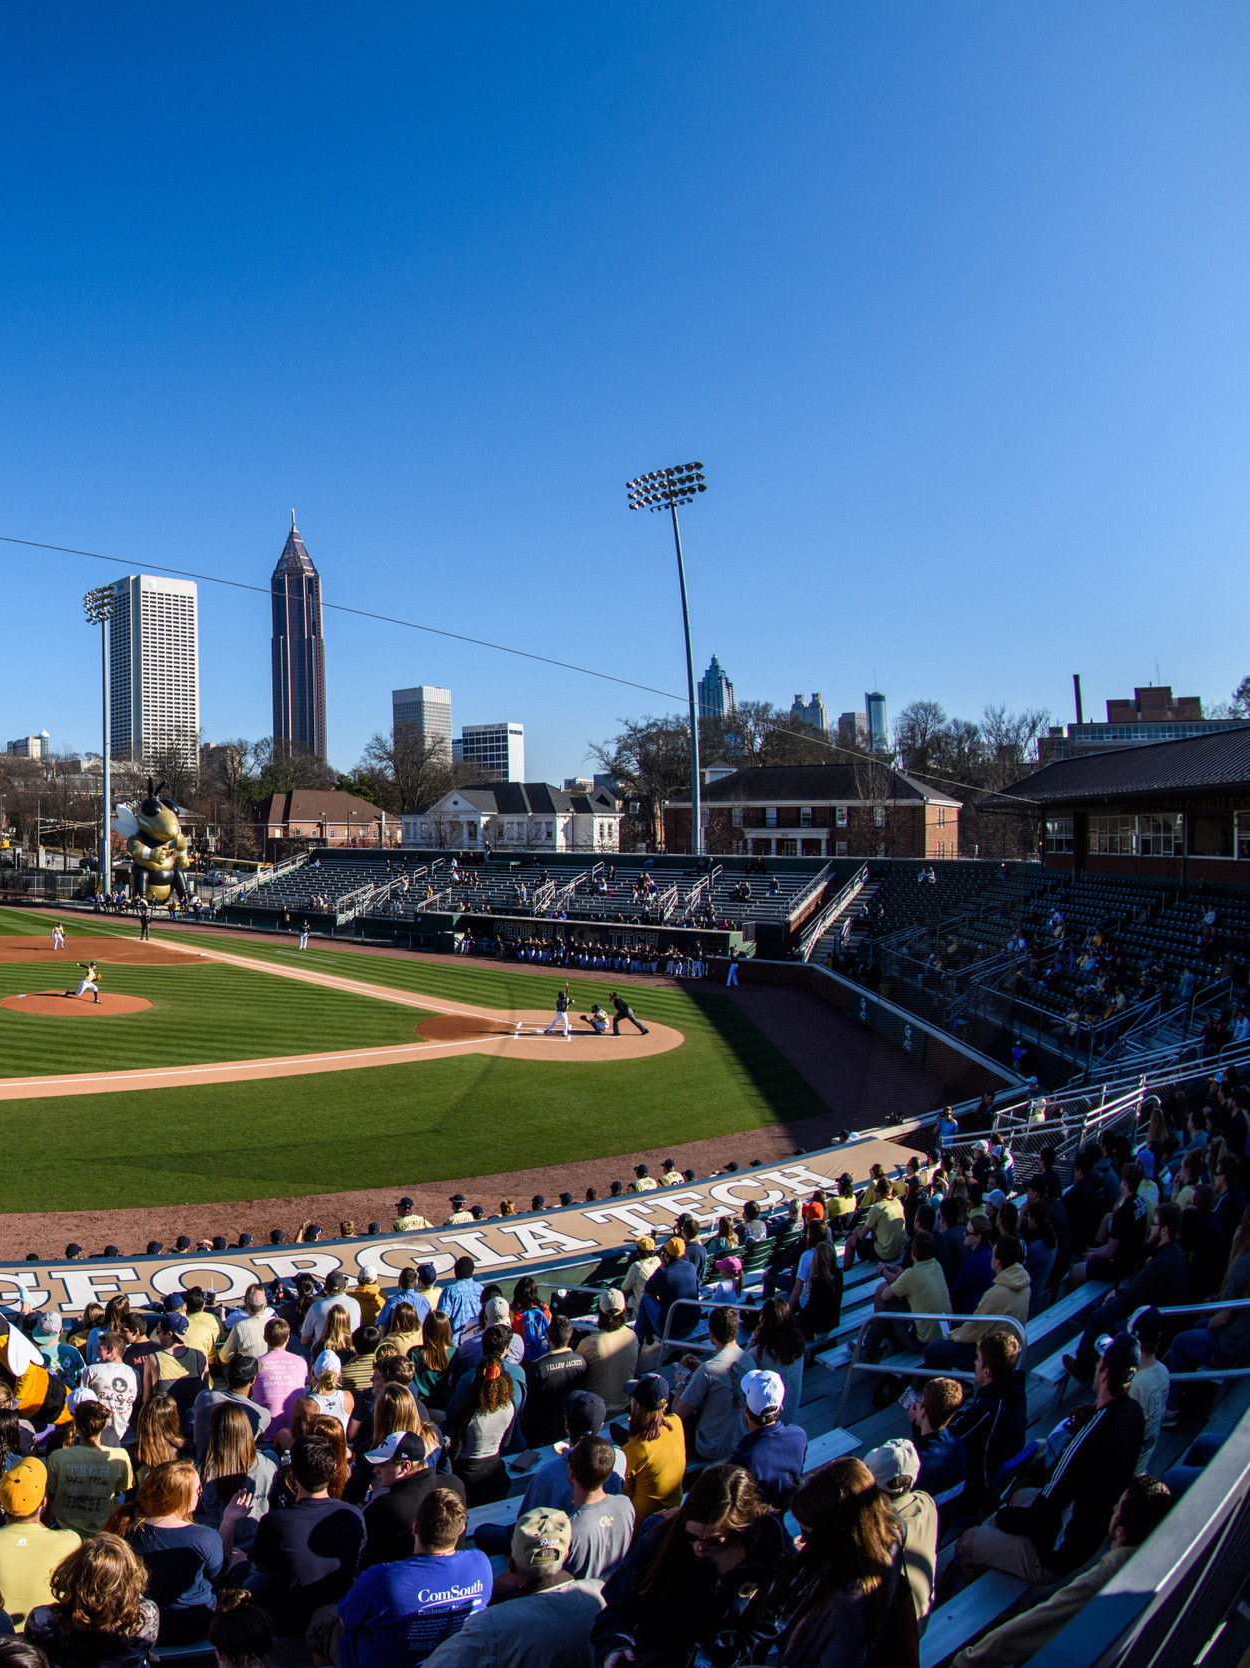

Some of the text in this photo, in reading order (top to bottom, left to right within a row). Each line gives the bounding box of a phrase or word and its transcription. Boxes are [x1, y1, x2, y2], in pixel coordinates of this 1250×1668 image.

[494, 921, 565, 941] GEORGIA
[609, 929, 659, 948] TECH
[581, 1164, 842, 1238] TECH
[546, 1360, 583, 1371] YELLOW JACKETS
[65, 1463, 110, 1477] TECH
[418, 1579, 483, 1602] ComSouth
[418, 1606, 450, 1616] Customer
